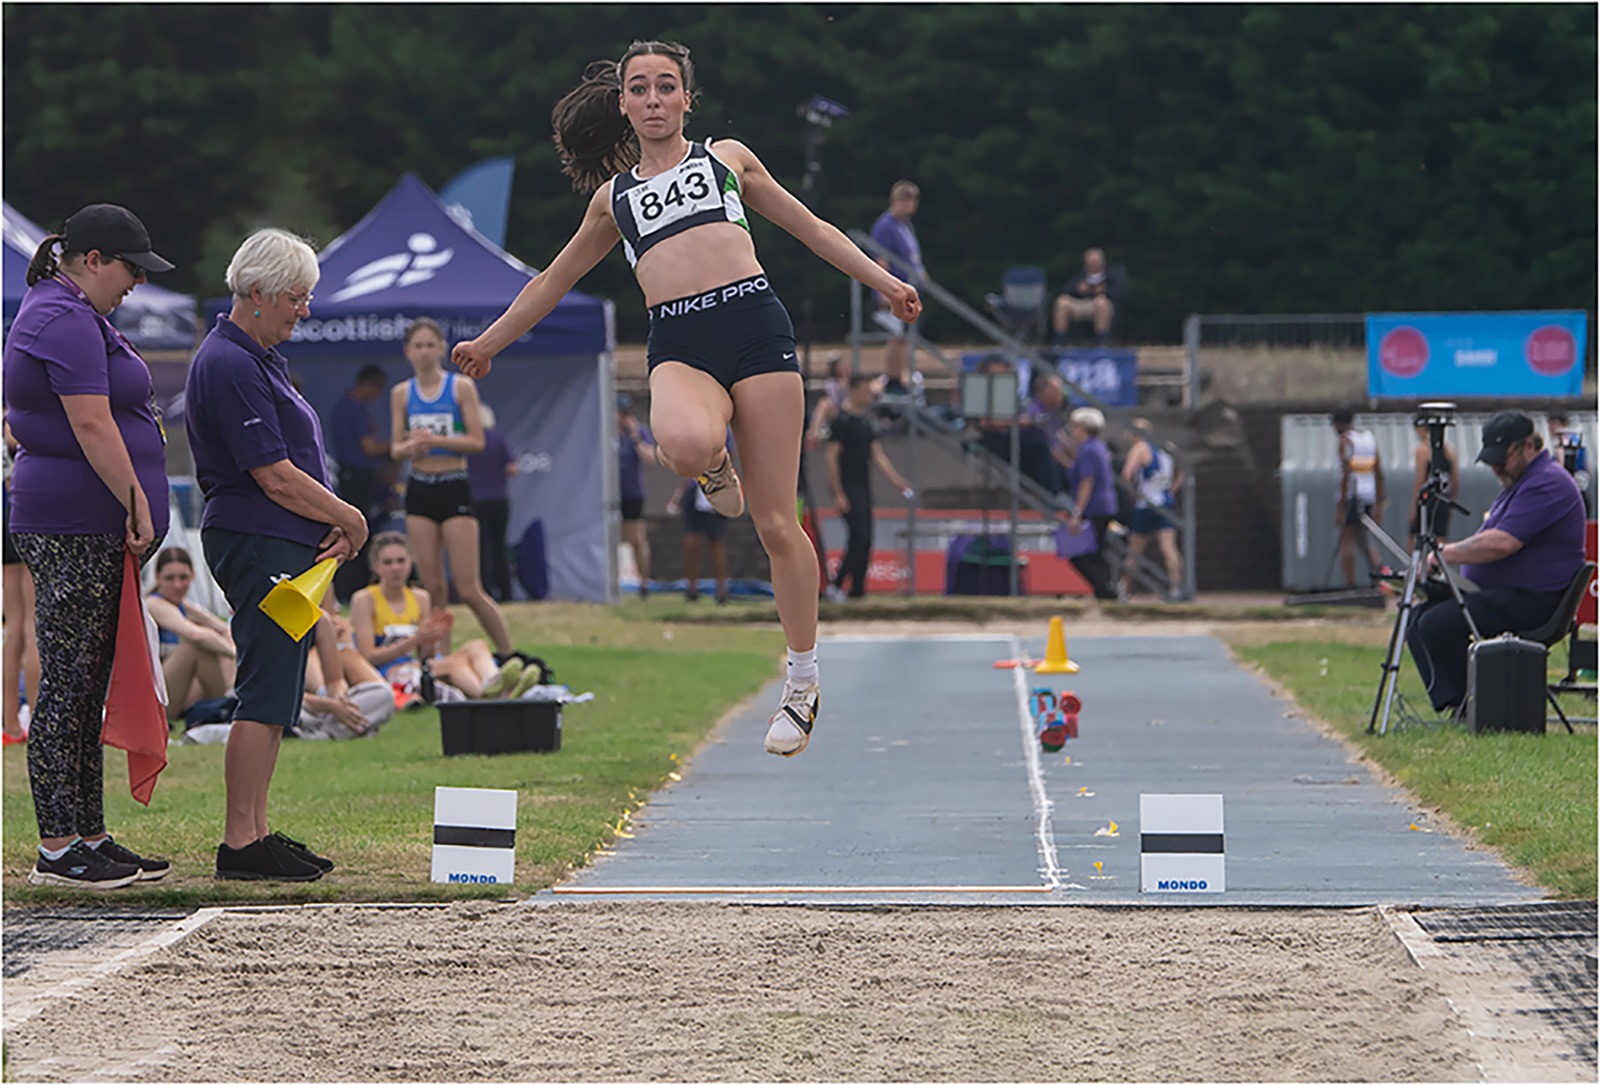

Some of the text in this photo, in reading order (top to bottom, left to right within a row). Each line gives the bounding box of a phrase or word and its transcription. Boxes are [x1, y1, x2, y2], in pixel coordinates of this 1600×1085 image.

[640, 172, 710, 220] 843
[660, 292, 717, 319] NIKE
[722, 277, 769, 303] PRO
[448, 873, 497, 884] MONDO
[1157, 880, 1208, 890] MONDO
